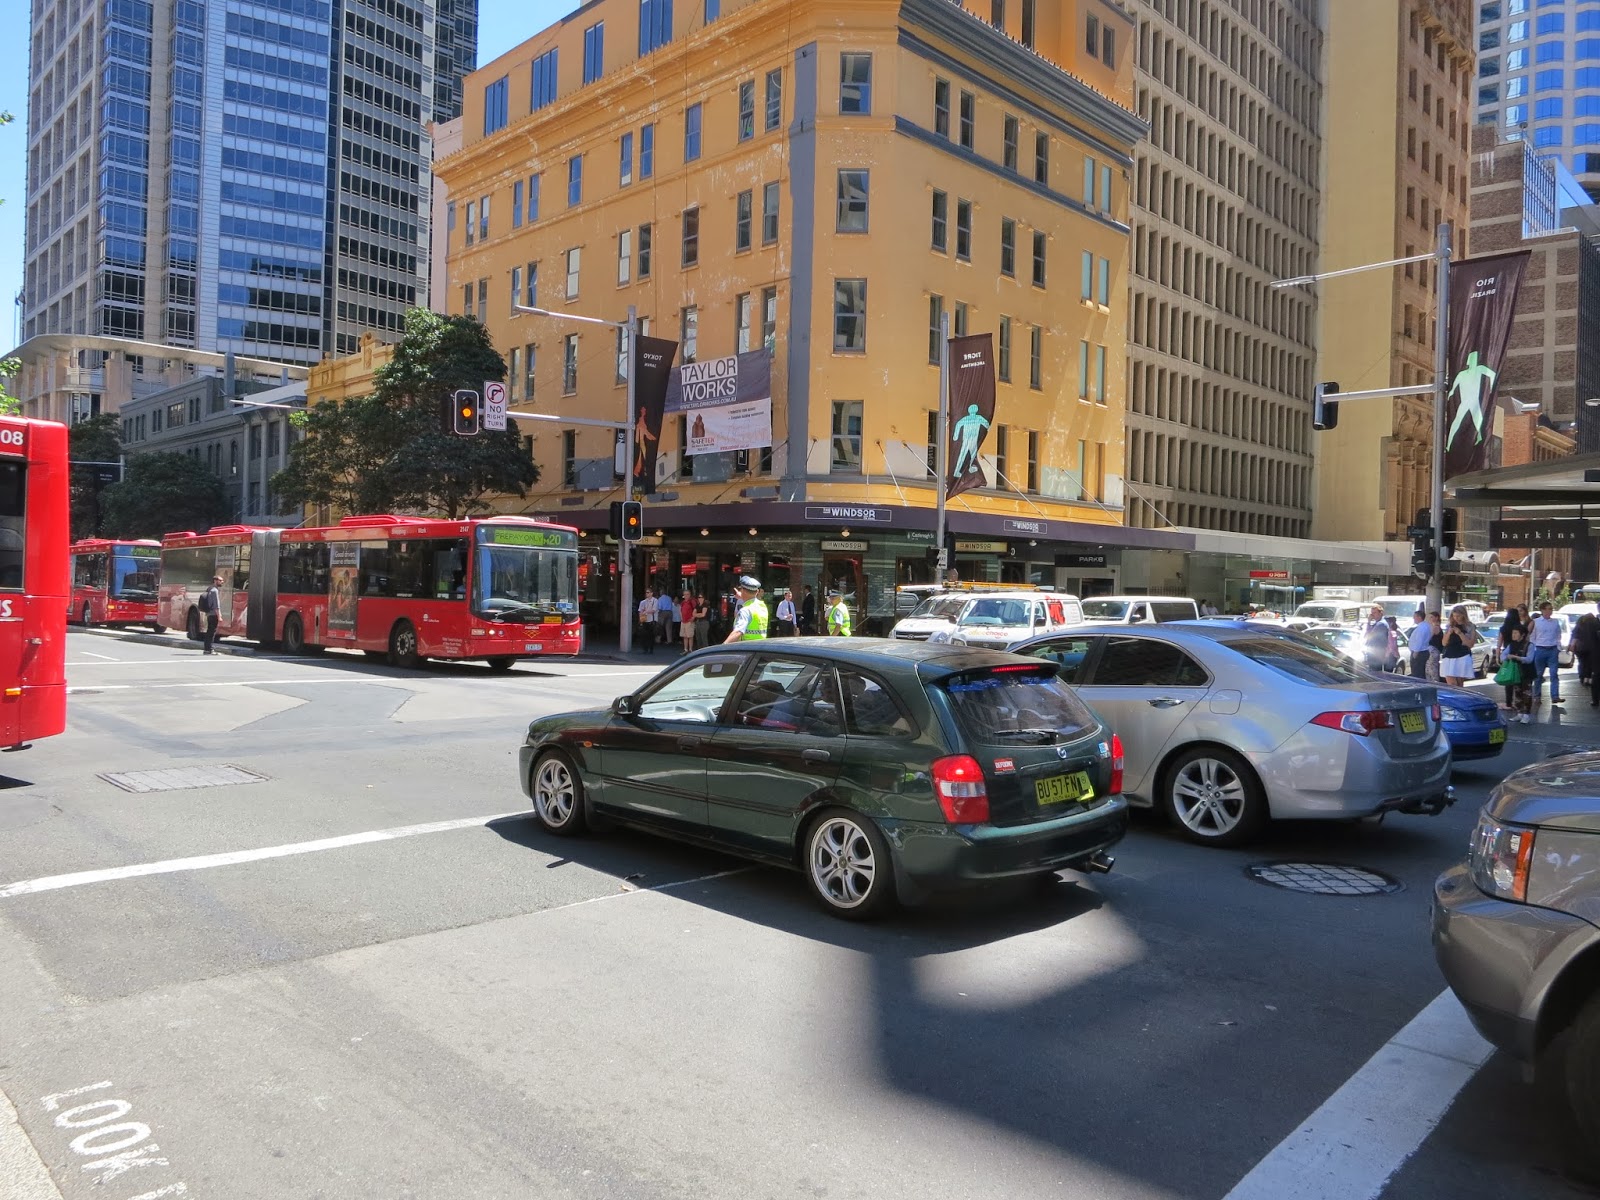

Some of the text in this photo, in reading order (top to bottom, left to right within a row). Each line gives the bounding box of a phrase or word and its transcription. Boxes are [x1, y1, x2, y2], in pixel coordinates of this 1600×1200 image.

[681, 357, 736, 382] TAYLOR
[682, 378, 736, 402] WORKS
[490, 405, 502, 414] NO
[486, 413, 504, 421] RIGHT
[831, 508, 876, 518] WINDSOR
[495, 532, 544, 543] PREPAY ONLY
[1501, 530, 1575, 539] barkins
[0, 599, 12, 617] S
[40, 1080, 170, 1190] LOOK
